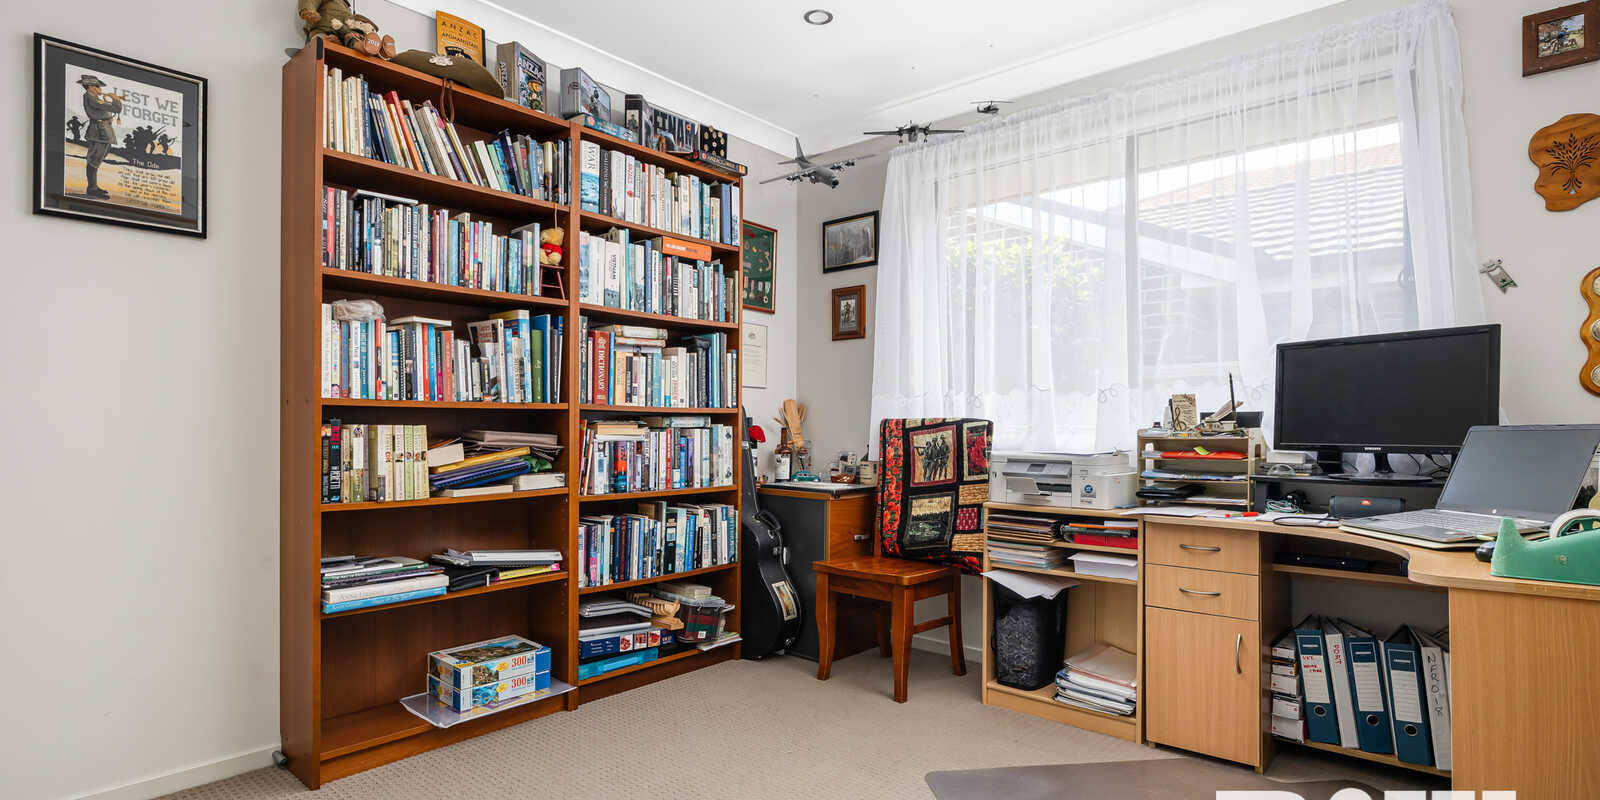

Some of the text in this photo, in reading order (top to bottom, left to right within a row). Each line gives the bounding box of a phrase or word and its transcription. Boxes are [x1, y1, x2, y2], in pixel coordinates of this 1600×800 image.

[156, 97, 179, 114] WE
[121, 104, 179, 128] FORGET
[511, 655, 527, 668] 300
[511, 676, 527, 688] 300
